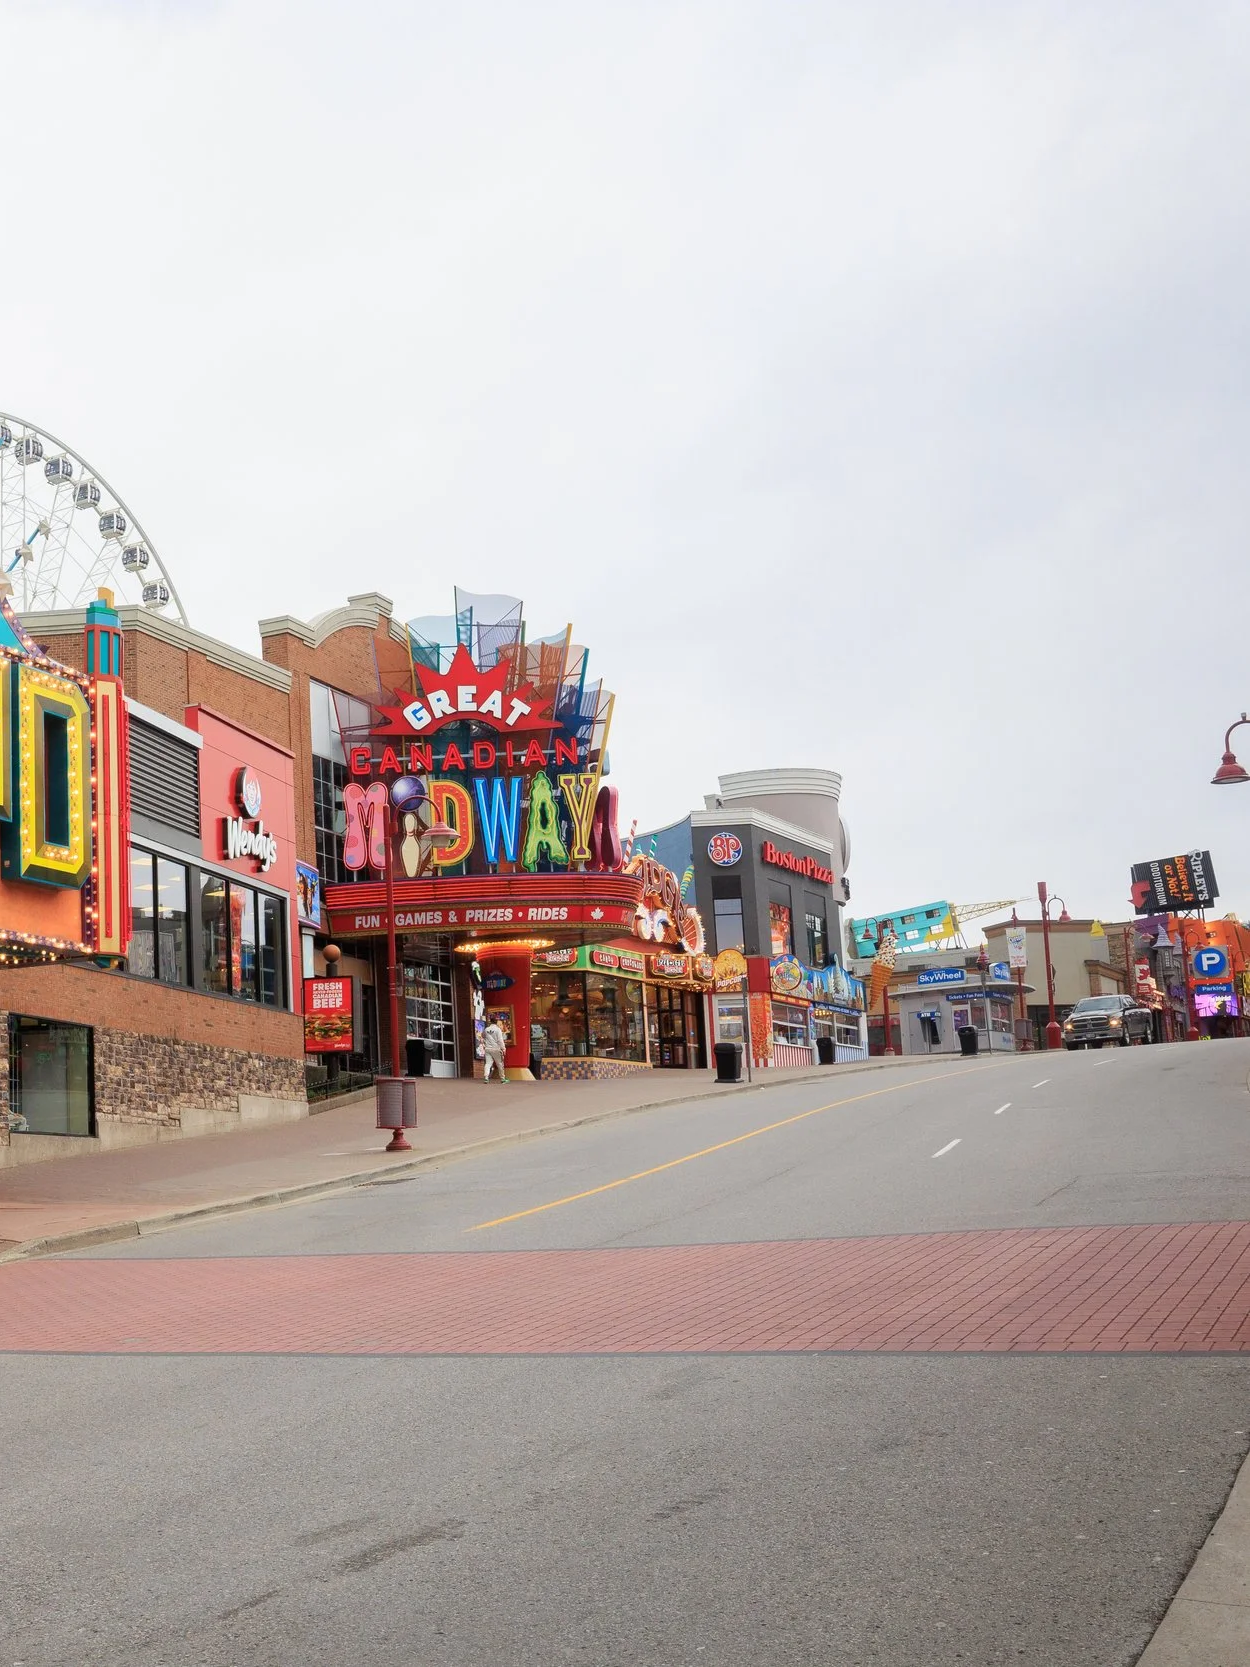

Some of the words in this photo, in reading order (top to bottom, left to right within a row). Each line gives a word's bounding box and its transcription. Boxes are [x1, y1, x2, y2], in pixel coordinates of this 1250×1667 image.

[403, 685, 531, 730] GREAT
[350, 737, 578, 775] CANADIAN
[343, 770, 597, 878] MIDWAY
[227, 816, 277, 872] Wendy's
[711, 836, 741, 862] BP
[1164, 864, 1173, 875] or
[1174, 856, 1189, 891] Believe
[1183, 893, 1194, 902] It
[1188, 849, 1209, 901] RIPLEY'S
[1150, 862, 1167, 906] ODDITORIUM
[1166, 877, 1181, 897] Not!
[355, 913, 380, 929] FUN
[395, 911, 442, 926] GAMES
[449, 911, 457, 922] &
[465, 908, 513, 922] PRIZES
[528, 907, 568, 921] RIDES
[1201, 953, 1221, 971] P
[313, 982, 342, 991] FRESH
[717, 973, 748, 987] POPCORN
[919, 970, 962, 983] SkyWheel
[313, 998, 342, 1009] BEEF
